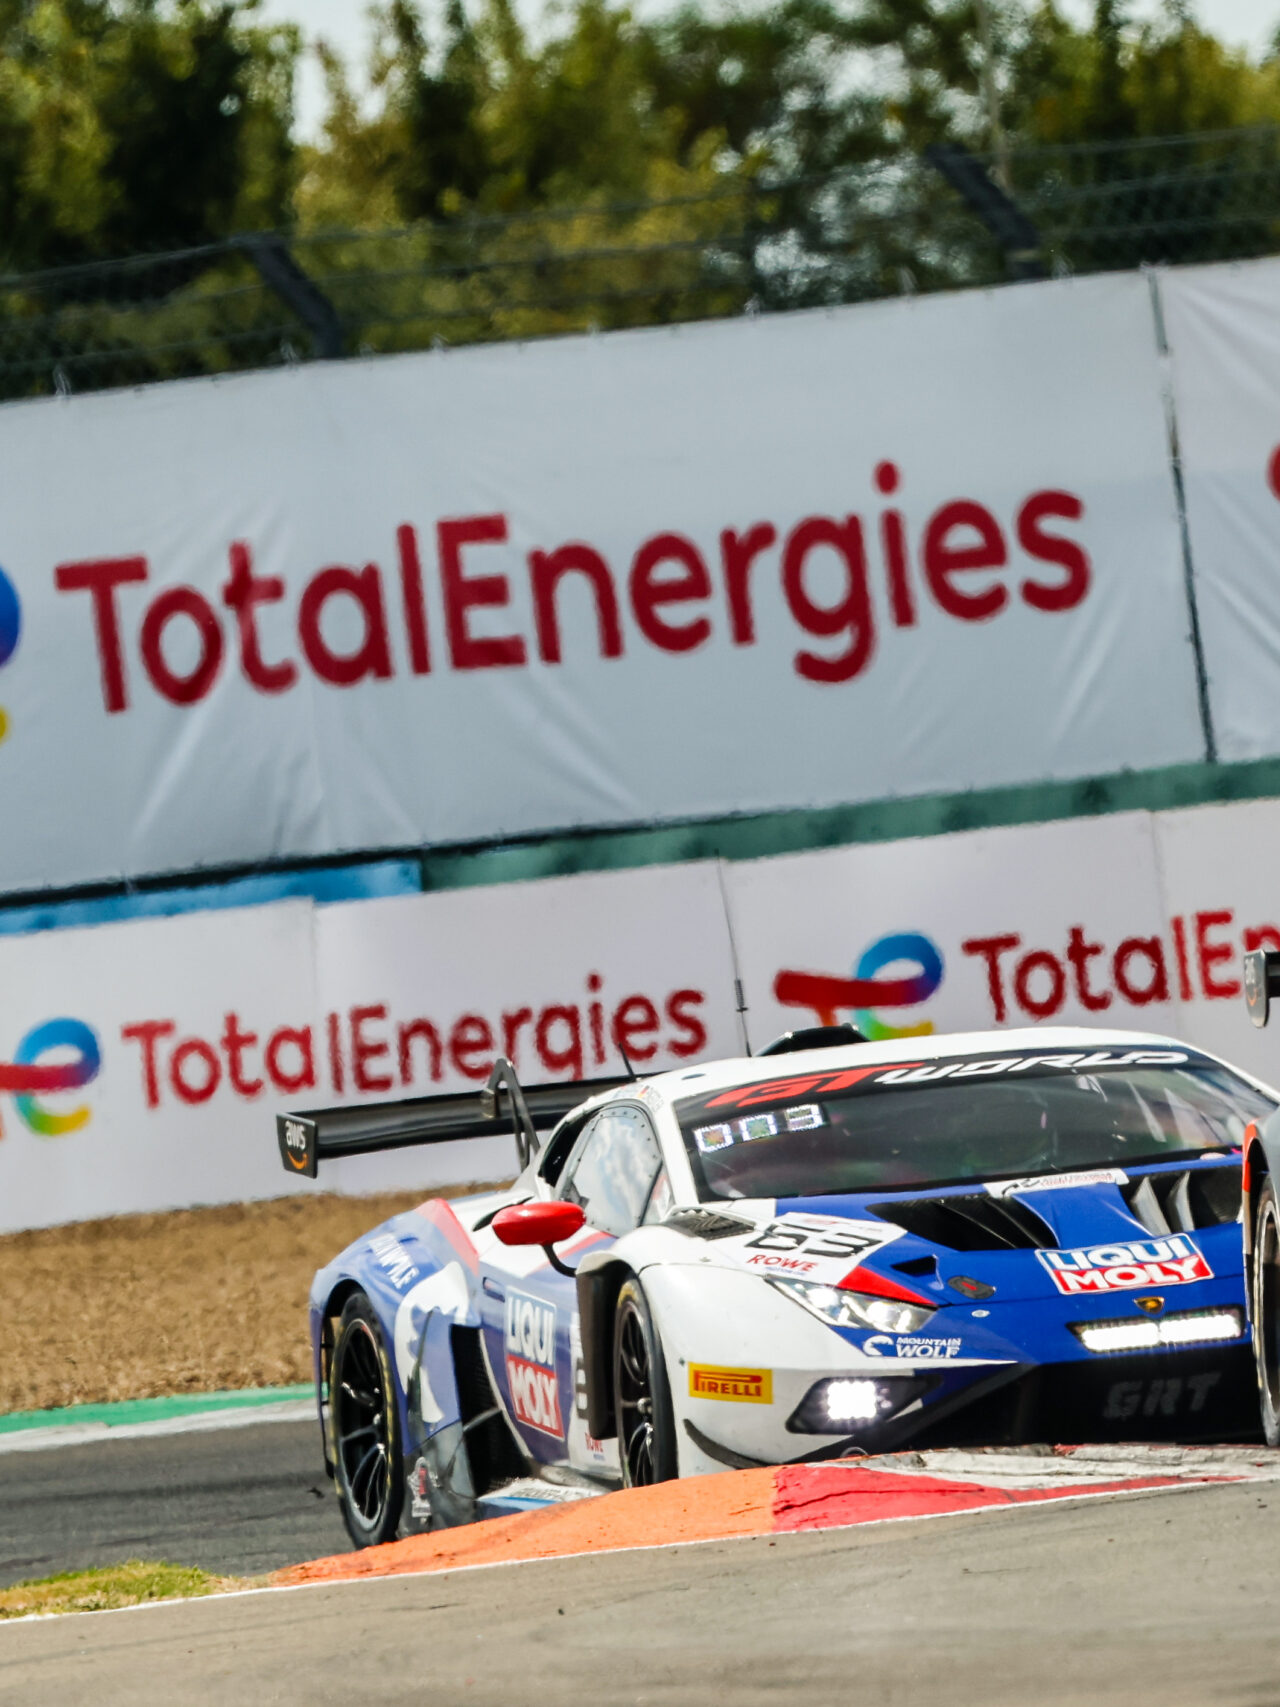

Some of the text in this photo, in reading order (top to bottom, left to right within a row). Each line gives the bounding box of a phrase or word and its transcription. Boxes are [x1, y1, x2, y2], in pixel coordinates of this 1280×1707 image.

[55, 462, 1091, 713] TotalEnergies
[122, 973, 708, 1109] TotalEnergies
[706, 1062, 924, 1108] GT
[874, 1051, 1189, 1085] WORLD
[285, 1120, 306, 1150] aws
[744, 1223, 884, 1259] 63
[1046, 1237, 1192, 1271] LIQUI
[747, 1253, 818, 1273] ROWE
[1059, 1256, 1201, 1291] MOLY
[507, 1295, 556, 1366] LIQUI
[897, 1336, 962, 1347] MOUNTAIN
[895, 1344, 960, 1358] WOLF
[507, 1360, 559, 1431] MOLY
[693, 1369, 763, 1397] PIRELLI
